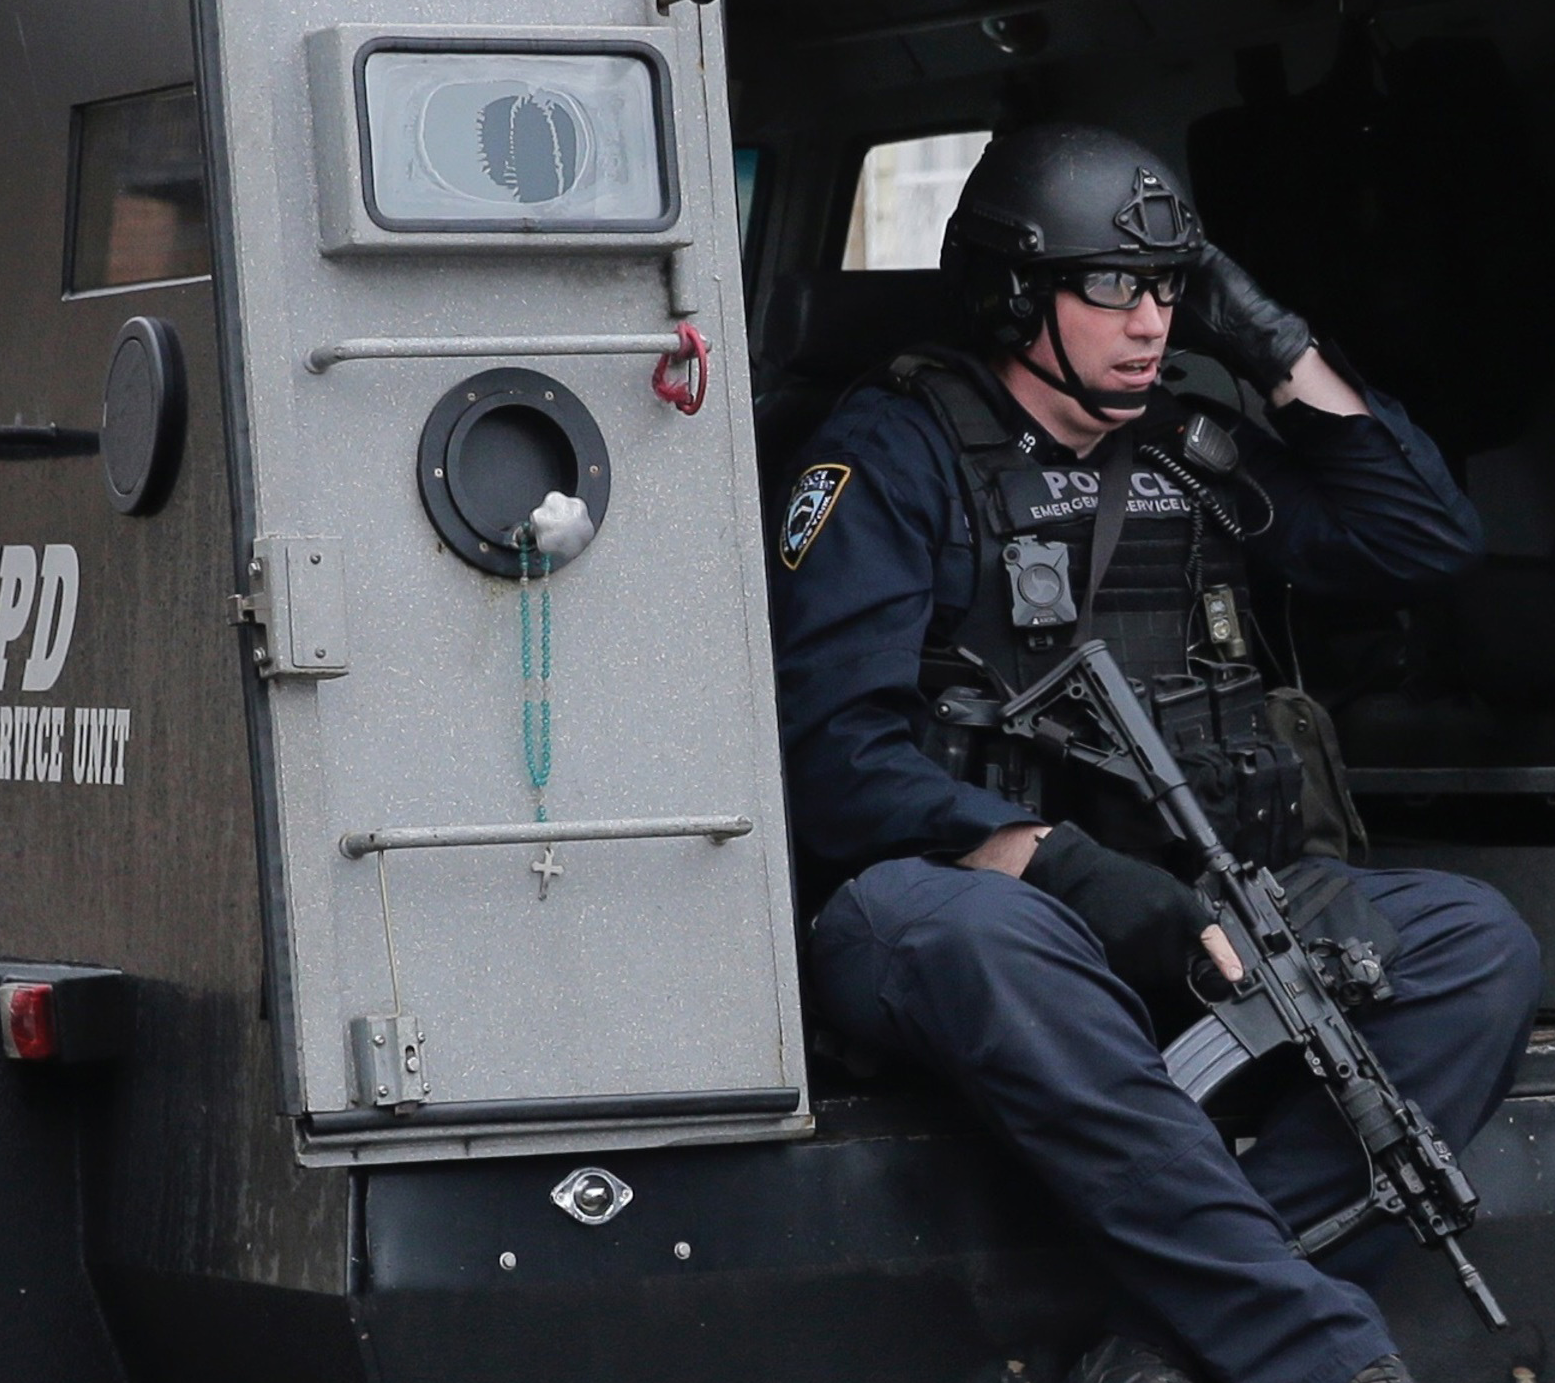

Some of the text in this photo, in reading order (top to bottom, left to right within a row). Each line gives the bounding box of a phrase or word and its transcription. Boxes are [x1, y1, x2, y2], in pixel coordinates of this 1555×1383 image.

[1042, 471, 1183, 499] POCE
[1125, 498, 1180, 513] ERVICE
[73, 707, 131, 786] UNIT
